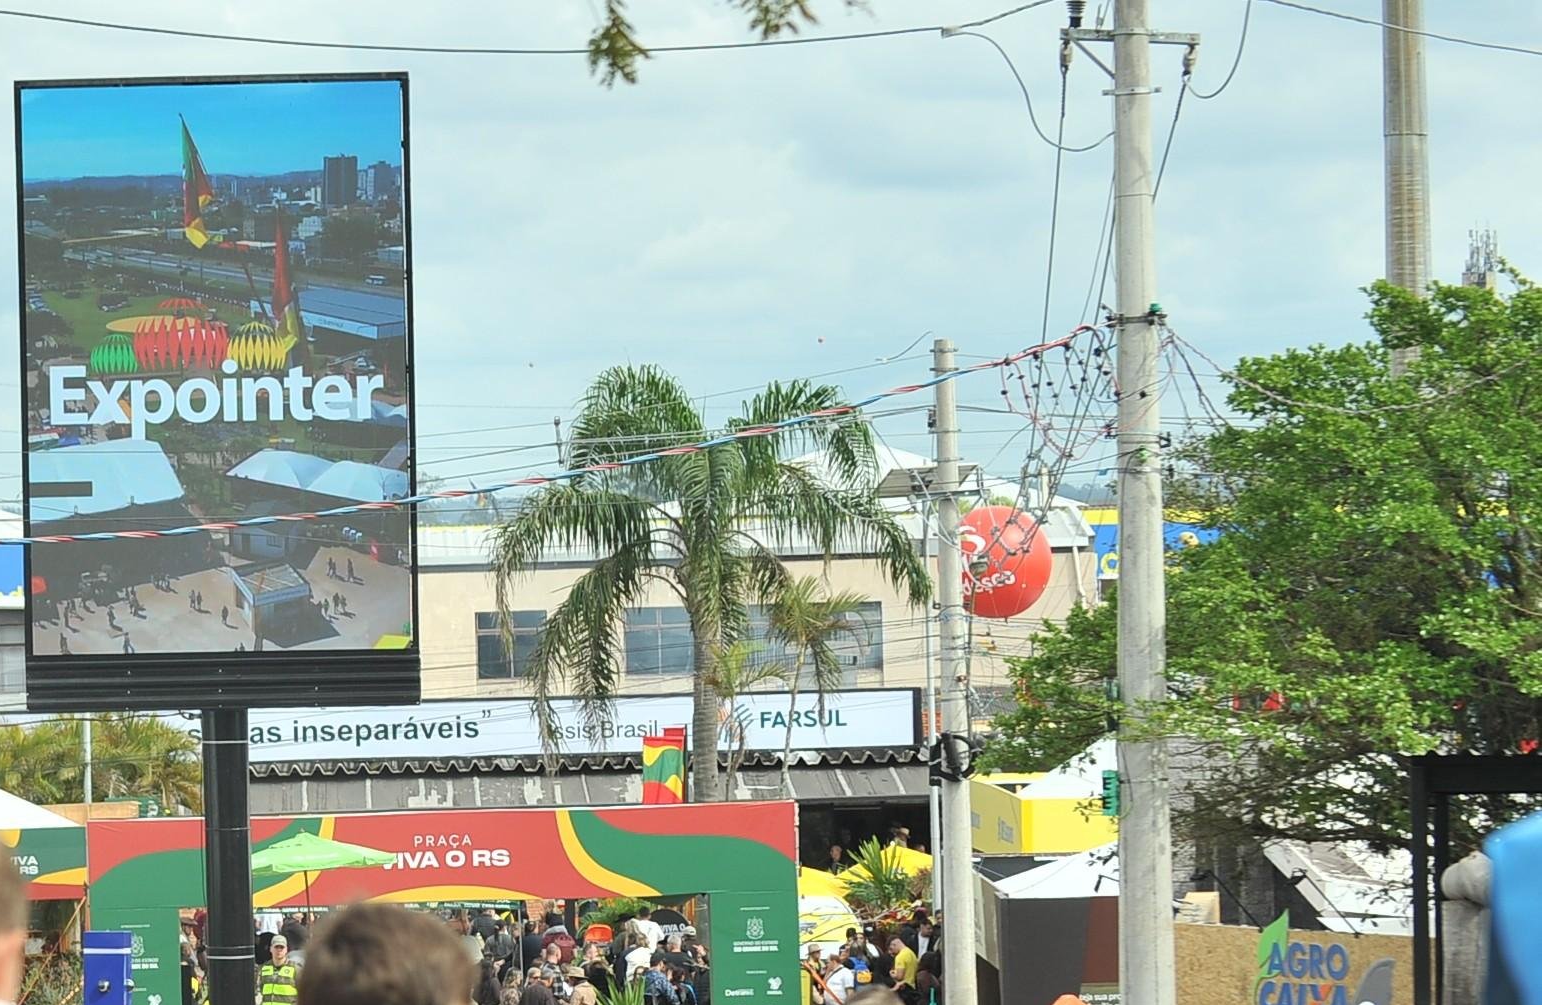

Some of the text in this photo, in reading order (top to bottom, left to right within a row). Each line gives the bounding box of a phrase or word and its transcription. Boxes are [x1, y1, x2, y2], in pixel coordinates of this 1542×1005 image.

[49, 360, 384, 440] Expointer
[760, 709, 847, 728] FARSUL
[601, 719, 658, 739] Brasil
[413, 834, 472, 848] PRAÇA
[445, 850, 466, 868] O
[472, 849, 511, 868] RS
[1266, 942, 1348, 980] AGRO
